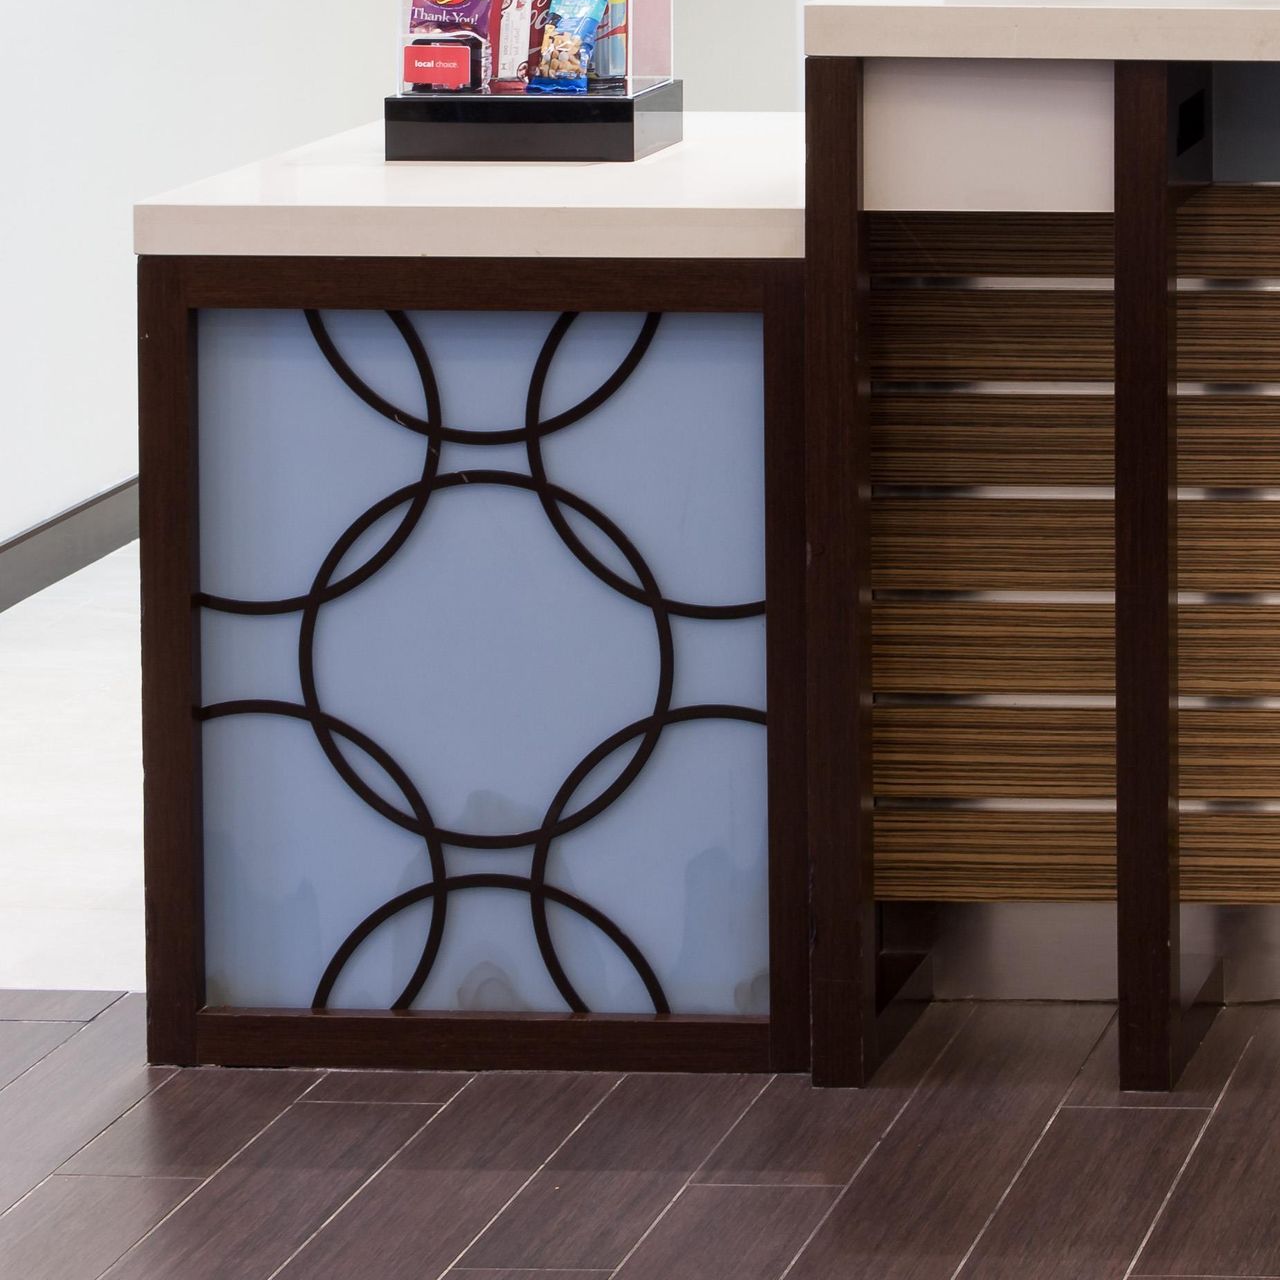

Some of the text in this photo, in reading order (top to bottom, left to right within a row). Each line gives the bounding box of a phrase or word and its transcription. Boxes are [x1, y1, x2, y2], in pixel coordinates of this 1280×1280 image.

[412, 6, 479, 25] Thank You!
[414, 59, 434, 68] local
